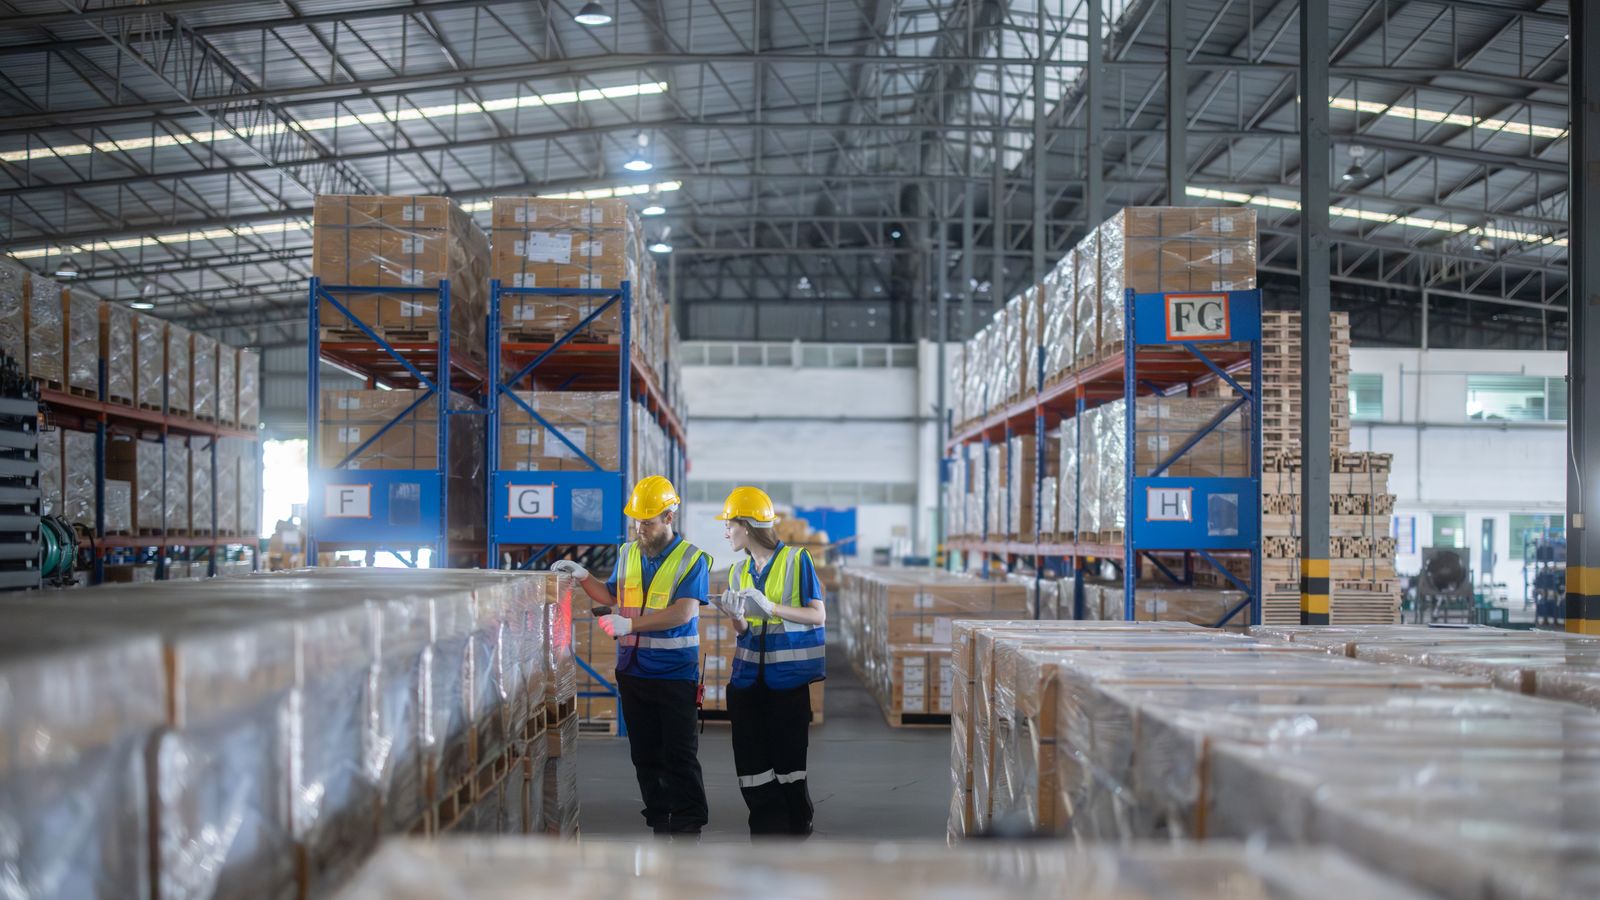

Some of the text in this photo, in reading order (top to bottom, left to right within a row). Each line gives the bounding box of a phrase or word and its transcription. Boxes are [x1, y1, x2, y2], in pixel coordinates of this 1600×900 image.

[1172, 301, 1225, 333] FG
[340, 489, 354, 514] F
[518, 489, 540, 515] G
[1161, 492, 1179, 516] H
